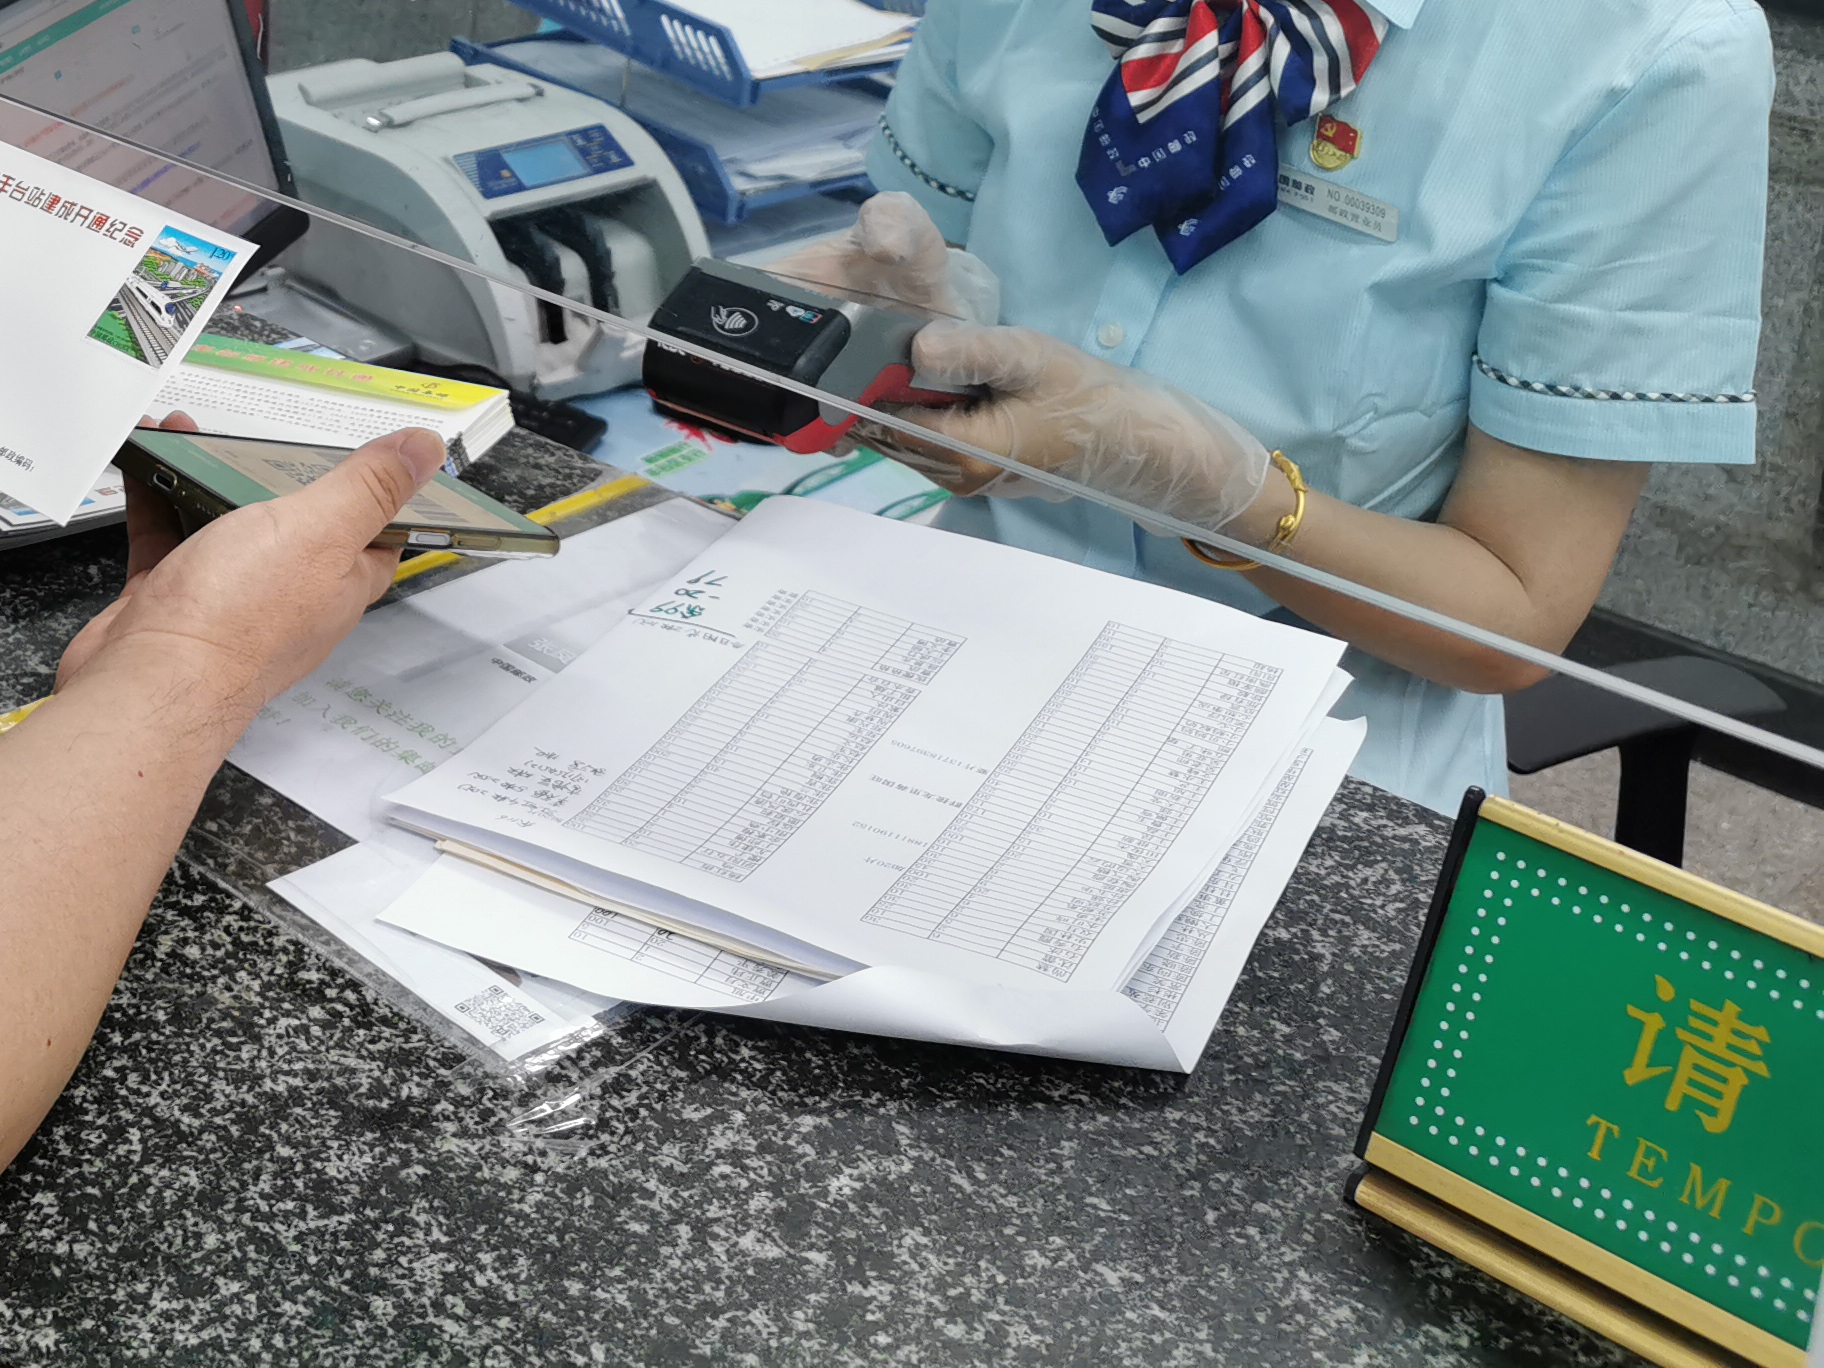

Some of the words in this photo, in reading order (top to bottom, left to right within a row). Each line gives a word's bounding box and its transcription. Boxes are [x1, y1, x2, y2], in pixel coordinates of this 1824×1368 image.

[1136, 130, 1198, 171] 中国邮政
[1622, 973, 1772, 1135] 请
